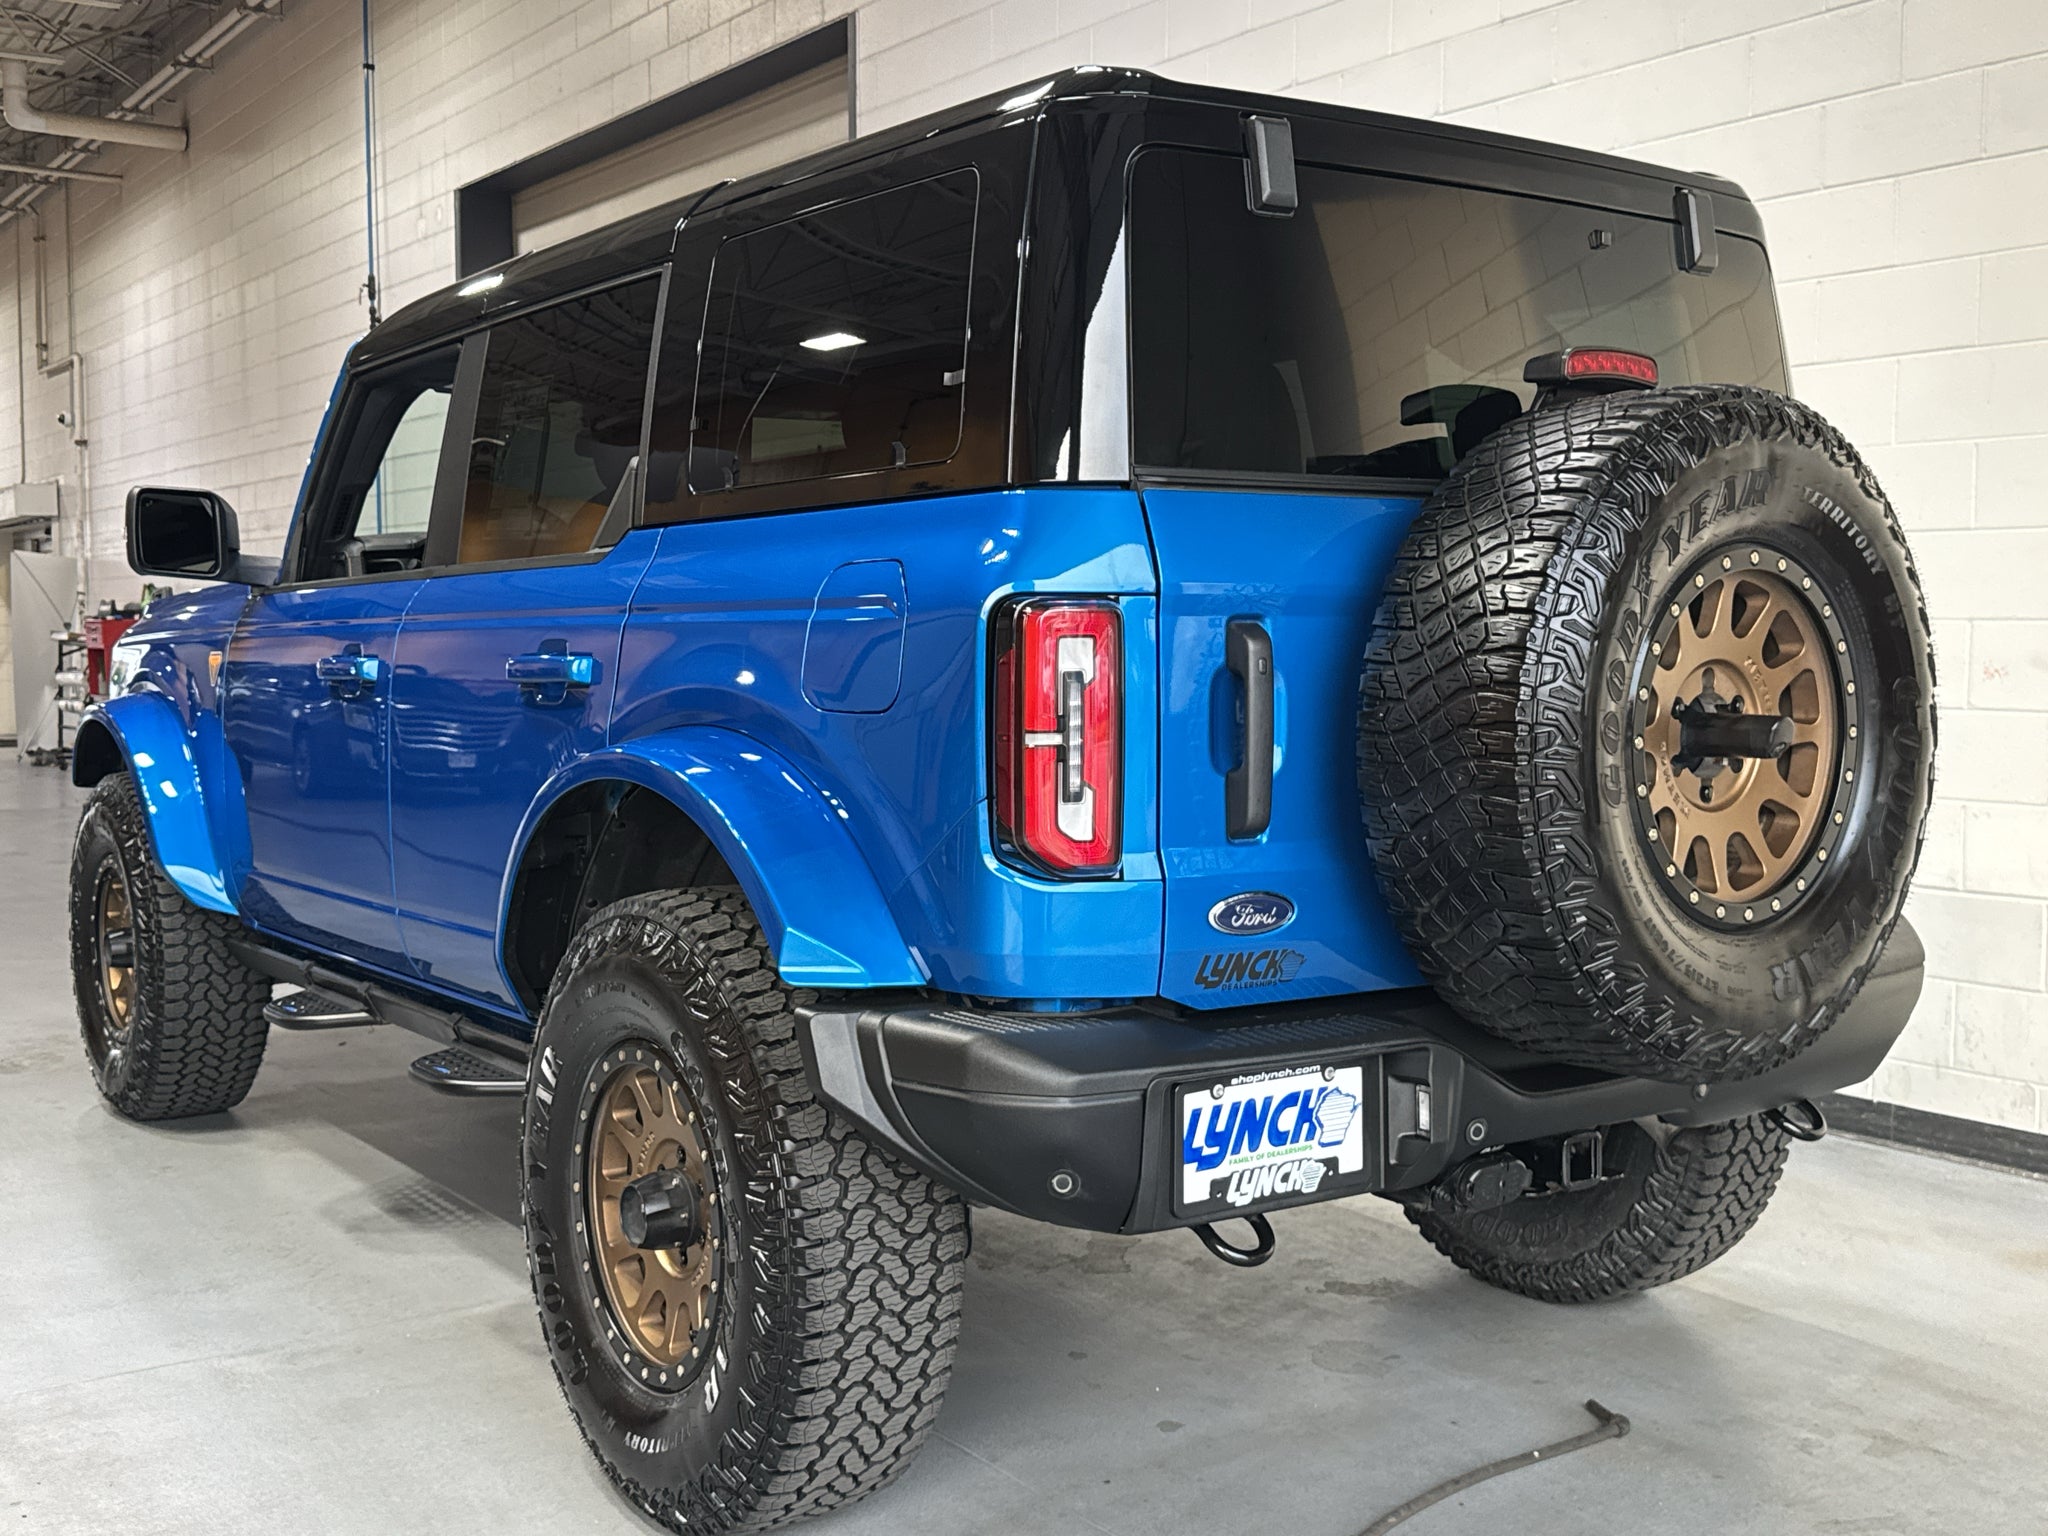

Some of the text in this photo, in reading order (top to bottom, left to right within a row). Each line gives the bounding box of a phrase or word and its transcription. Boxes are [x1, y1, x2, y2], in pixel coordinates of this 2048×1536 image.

[1802, 485, 1886, 576] TERRITORY
[1231, 904, 1277, 927] Ford
[1194, 948, 1289, 989] LYNCH
[1221, 979, 1278, 992] DEALERSHIPS
[1231, 1065, 1320, 1085] shoplynch.com
[1184, 1086, 1328, 1172] LYNCH
[1229, 1144, 1313, 1165] FAMILY OF DEALERSHIPS
[1226, 1160, 1307, 1207] LYNCH
